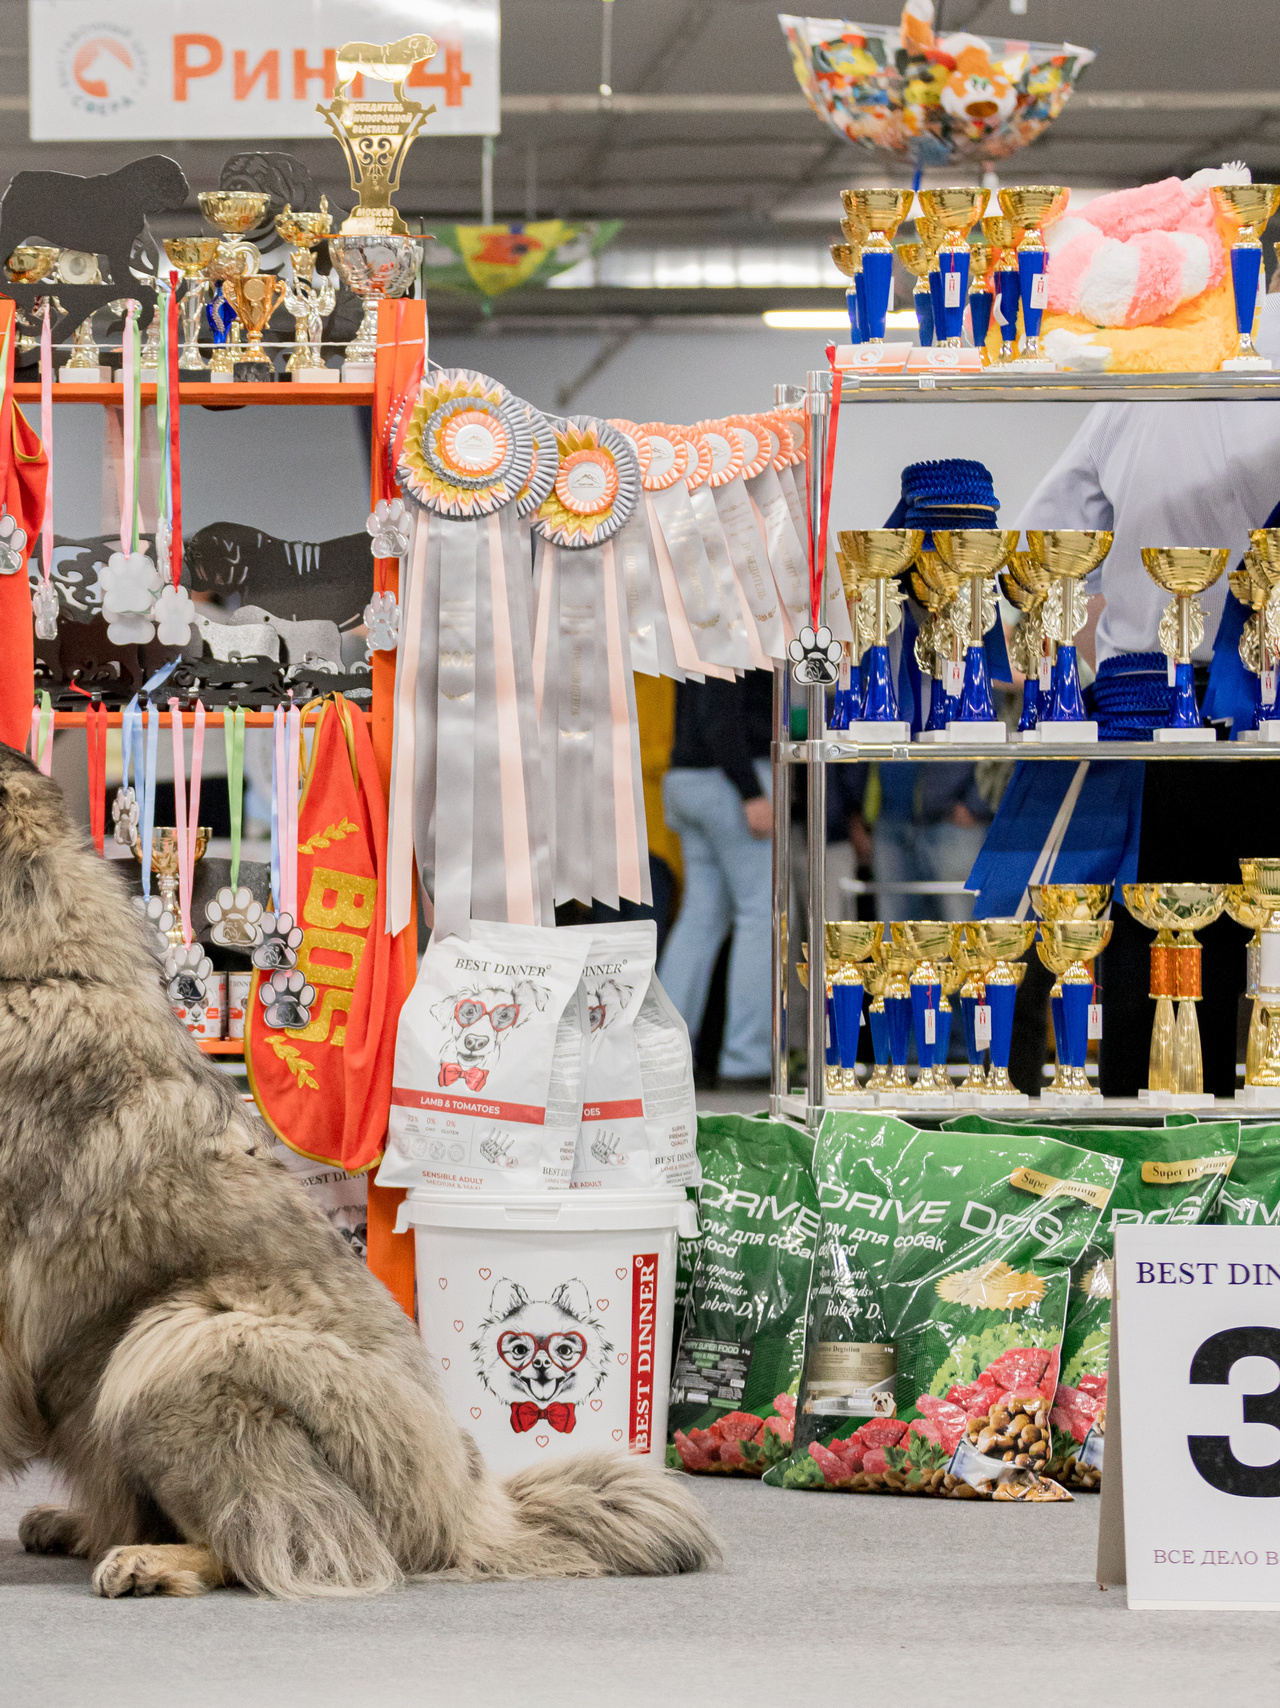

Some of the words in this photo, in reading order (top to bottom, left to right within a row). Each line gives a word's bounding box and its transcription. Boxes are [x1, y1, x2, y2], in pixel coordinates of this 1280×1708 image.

[348, 103, 404, 112] ПОБЕДИТЕЛЬ
[352, 124, 399, 134] ВЫСТАВКИ
[356, 208, 394, 217] МОСКВА
[376, 217, 394, 226] КЛС
[741, 541, 767, 601] ПОБЕДИТЕЛЬ
[454, 958, 491, 973] BEST
[494, 963, 547, 978] DINNER
[420, 1096, 443, 1107] LAMB
[444, 1101, 451, 1109] &
[452, 1100, 501, 1116] TOMATOES
[426, 1117, 437, 1126] 0%
[445, 1119, 456, 1129] 0%
[671, 1125, 686, 1133] SUPER
[441, 1128, 460, 1136] GLUTEN
[668, 1132, 689, 1141] PREMIUM
[670, 1139, 689, 1148] QUALITY
[654, 1154, 676, 1166] BEST
[422, 1170, 457, 1182] SENSIBLE
[458, 1175, 484, 1186] ADULT
[1021, 1172, 1049, 1190] Super
[1152, 1165, 1183, 1180] Super
[580, 1180, 602, 1189] ADULT
[699, 1178, 820, 1240] DRIVE
[817, 1181, 951, 1224] DRIVE
[959, 1200, 1063, 1246] DOG
[728, 1229, 766, 1246] для
[848, 1227, 890, 1246] для
[893, 1231, 948, 1254] собак
[704, 1236, 739, 1259] food
[706, 1263, 746, 1282] appetit
[1136, 1261, 1219, 1285] BEST
[637, 1262, 656, 1374] DINNER
[825, 1300, 863, 1318] Rober
[864, 1302, 882, 1320] D.
[698, 1342, 718, 1352] SUPER
[717, 1343, 740, 1355] FOOD
[635, 1380, 651, 1450] BEST
[1186, 1325, 1280, 1498] 3
[1153, 1549, 1195, 1564] ВСЕ
[1200, 1550, 1258, 1567] ДЕЛО
[1265, 1551, 1279, 1565] В
